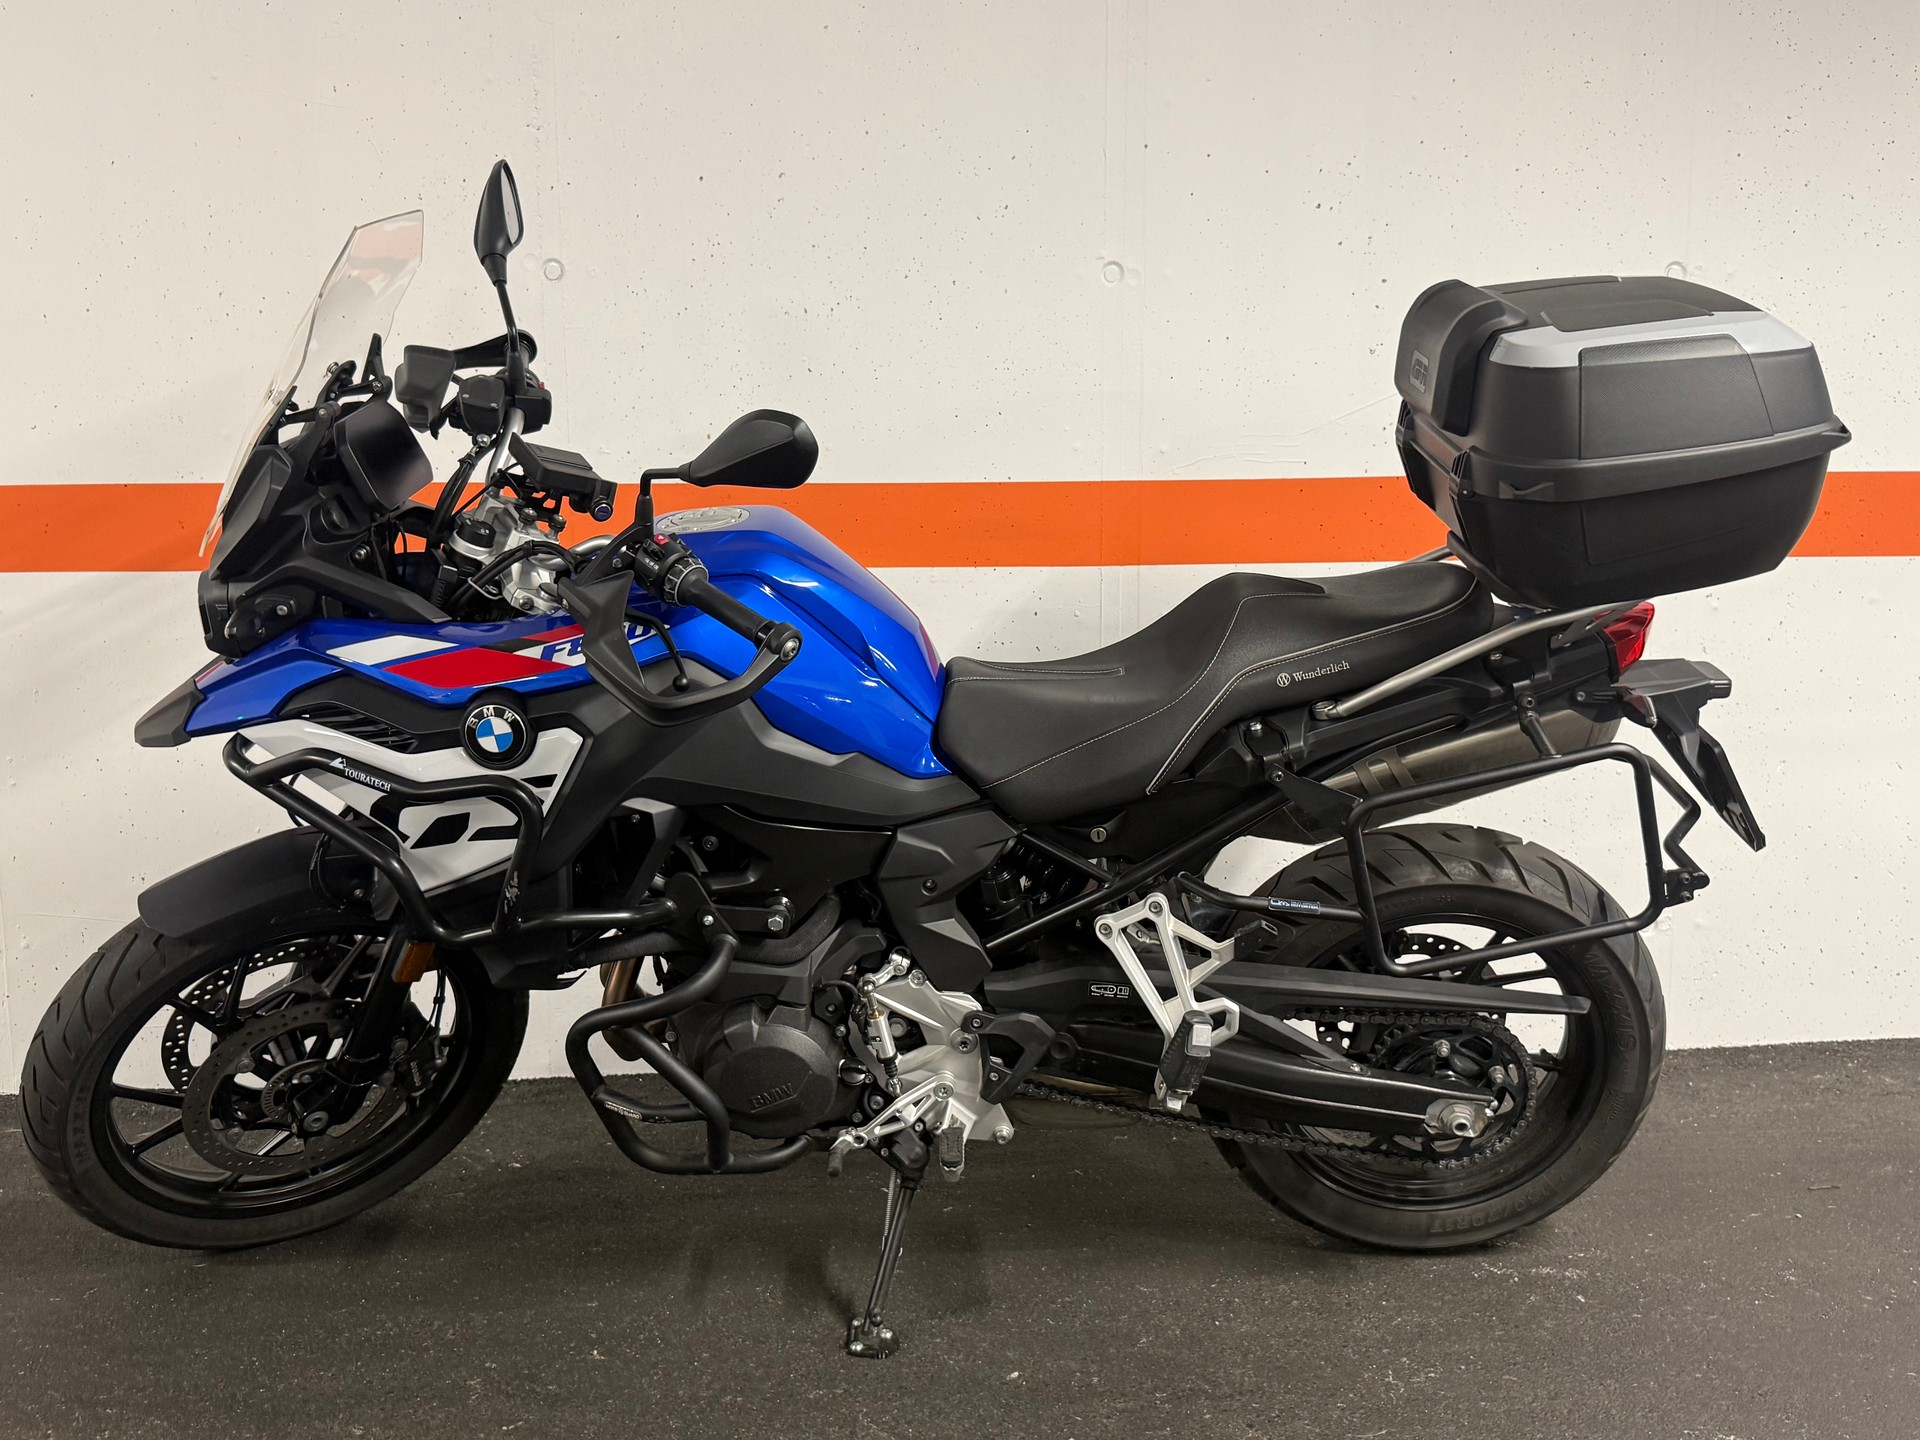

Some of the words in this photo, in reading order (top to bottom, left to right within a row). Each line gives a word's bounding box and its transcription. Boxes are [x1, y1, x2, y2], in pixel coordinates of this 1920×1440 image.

[1293, 661, 1350, 682] Wunderlich
[468, 707, 515, 729] BMW
[344, 768, 392, 792] TOURATECH
[750, 1083, 794, 1108] BMW
